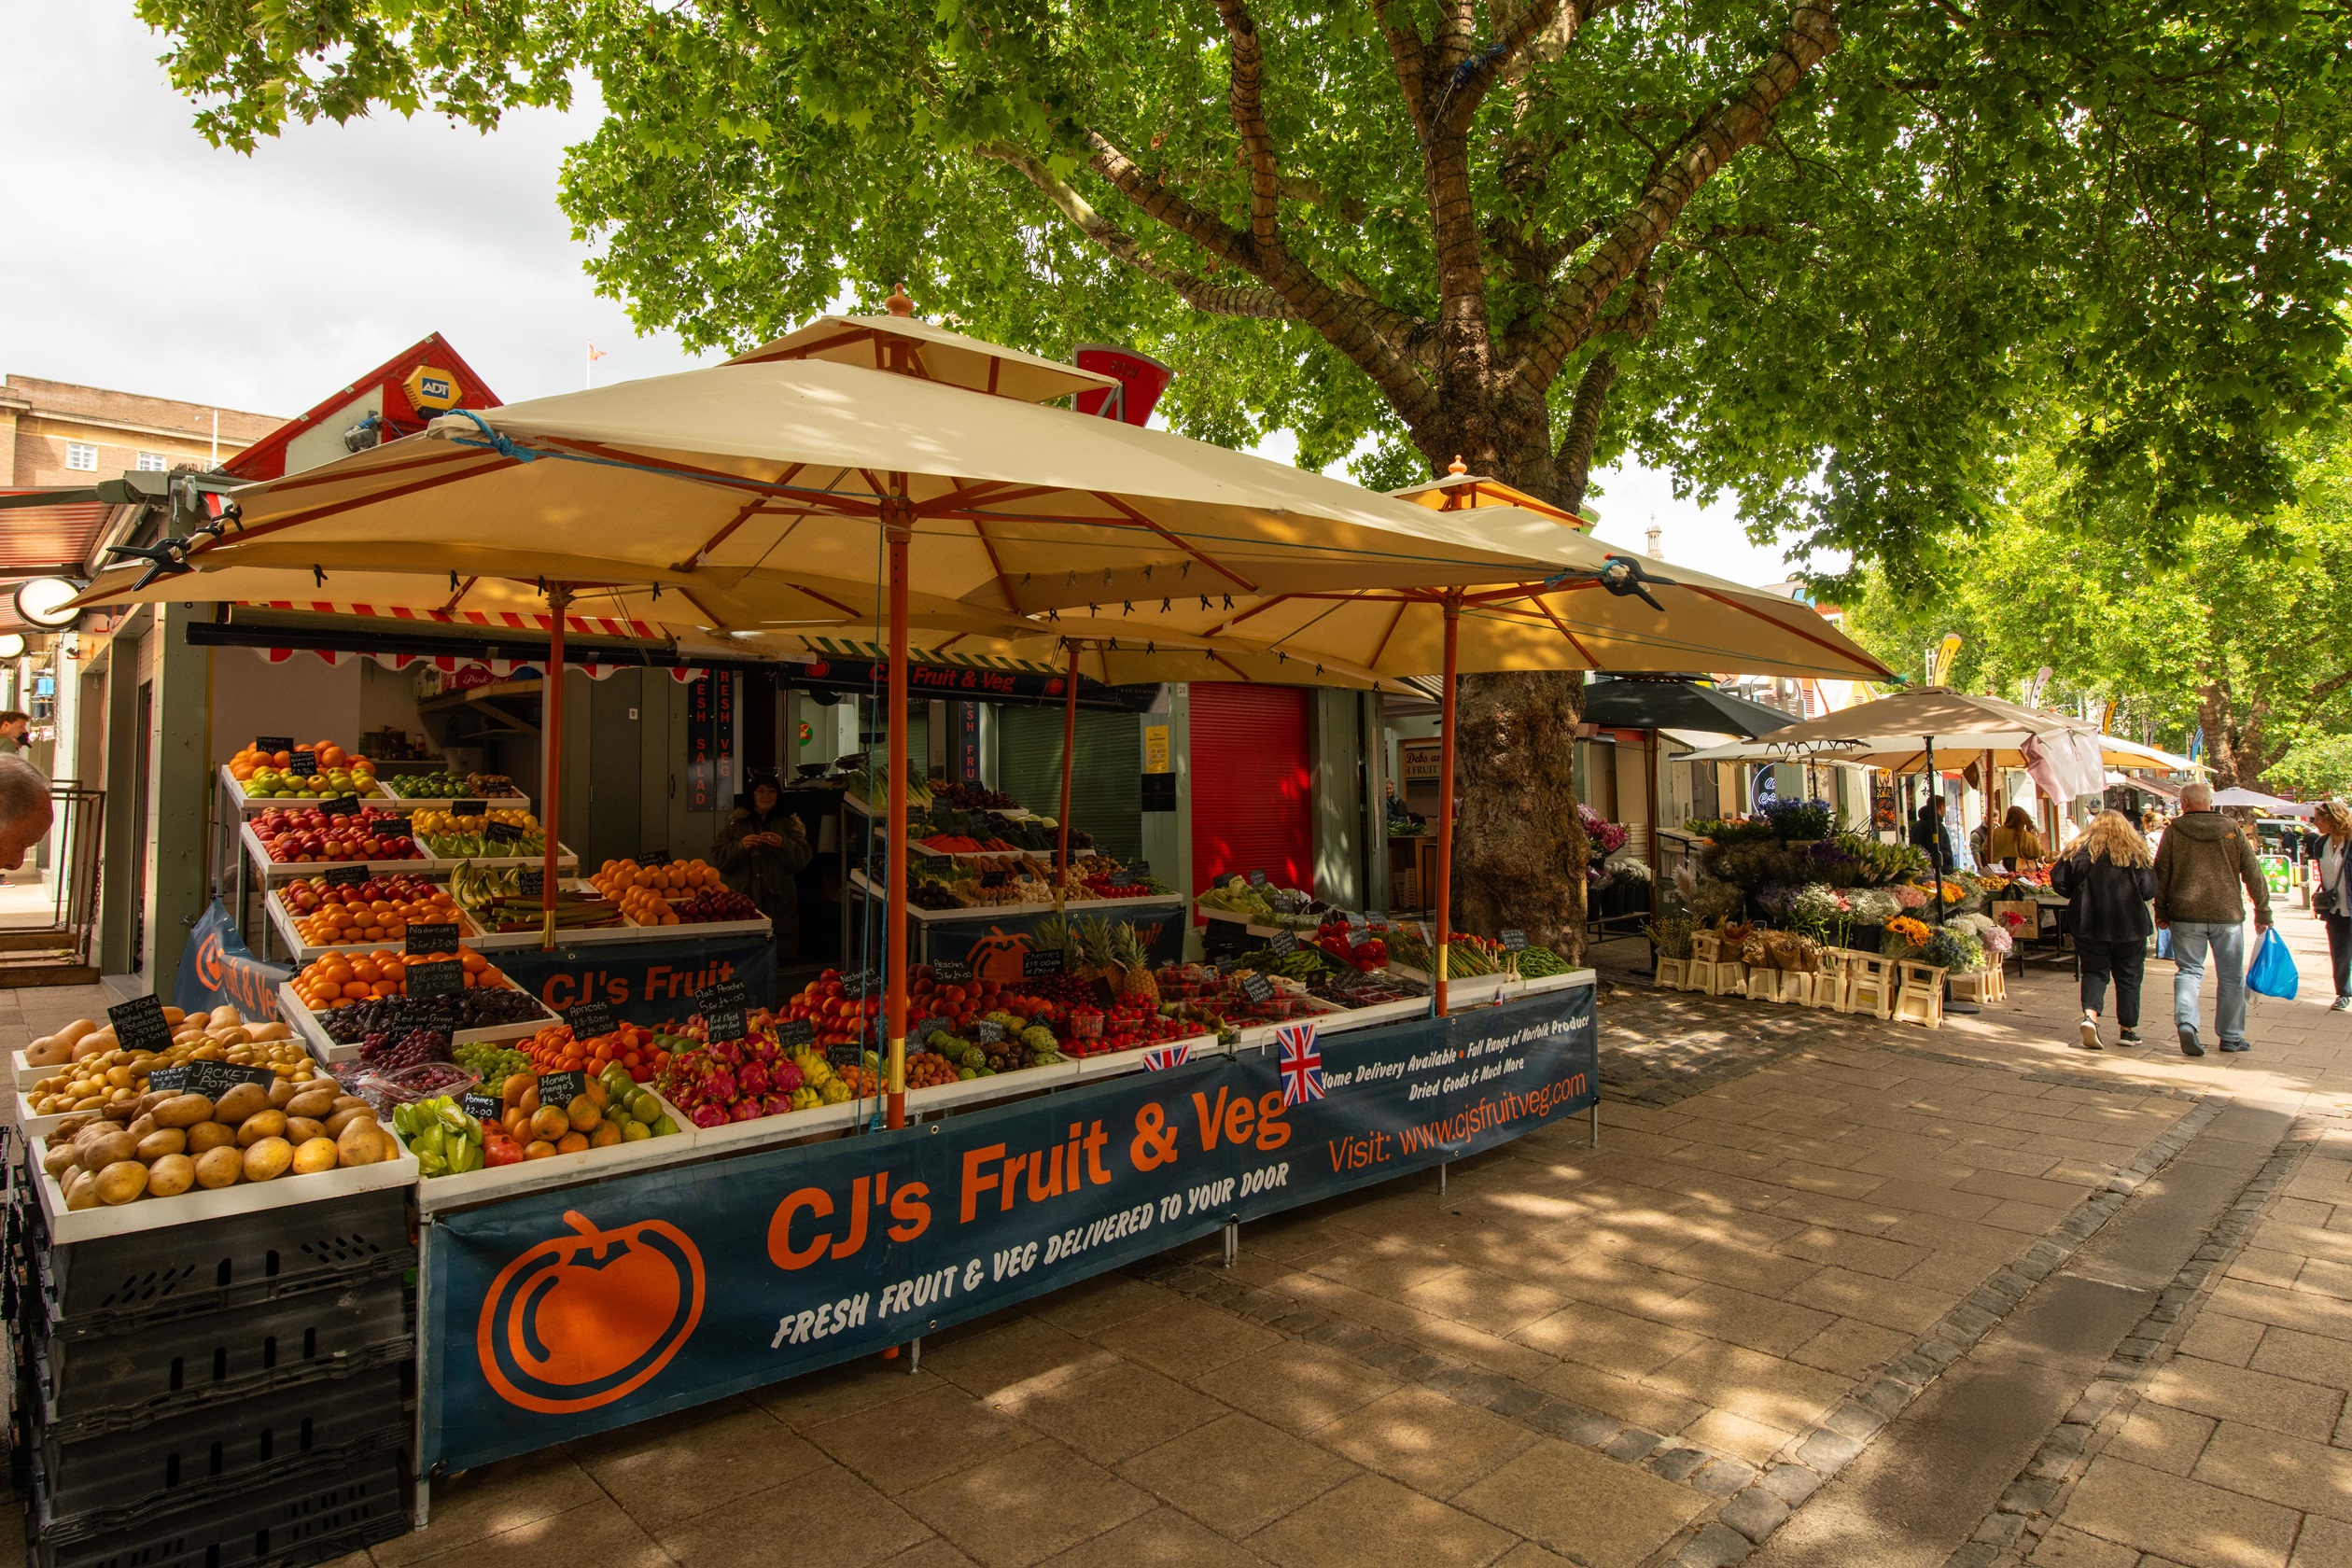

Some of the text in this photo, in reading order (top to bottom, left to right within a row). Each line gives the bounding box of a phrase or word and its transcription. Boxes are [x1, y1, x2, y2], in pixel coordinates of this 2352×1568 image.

[1110, 360, 1140, 379] ROW
[423, 382, 449, 396] ADT
[463, 674, 488, 684] Pink
[913, 666, 956, 687] Fruit
[960, 670, 976, 688] &
[982, 671, 1016, 693] Veg
[720, 671, 730, 777] RESH VEG
[694, 677, 707, 805] ESH SALAD
[966, 745, 975, 778] FRU
[1407, 752, 1428, 763] Debs
[1412, 765, 1437, 775] FRUIT
[408, 937, 418, 950] 5
[1025, 951, 1060, 961] Cherries
[933, 959, 965, 969] Peaches
[935, 968, 945, 980] 5
[542, 960, 735, 1011] CJ's Fruit
[694, 982, 745, 1001] Flat Peaches
[255, 971, 276, 1021] Ve
[569, 1001, 608, 1016] Apricots
[699, 1000, 709, 1015] 5
[709, 1002, 718, 1011] for
[121, 1014, 165, 1032] Potatoes
[394, 1012, 413, 1023] Red
[429, 1014, 454, 1023] Green
[1355, 1058, 1405, 1084] Delivery
[1407, 1046, 1458, 1072] Available
[1466, 1040, 1483, 1059] Full
[1485, 1034, 1510, 1055] Range
[1511, 1031, 1522, 1046] of
[1521, 1024, 1549, 1043] Norfolk
[1551, 1014, 1589, 1035] Produce
[151, 1066, 192, 1077] NORFO
[153, 1073, 184, 1082] NEW
[193, 1060, 255, 1083] JACKET
[1408, 1057, 1524, 1101] Dried Goods & Much More
[541, 1072, 571, 1087] Honey
[539, 1081, 575, 1095] mango's
[465, 1092, 495, 1106] Pommes
[1329, 1072, 1587, 1173] Visit: www.cjsfruitveg.com
[766, 1085, 1293, 1271] CJ's Fruit & Veg
[771, 1162, 1289, 1350] FRESH FRUIT & VEG DELIVERED TO YOUR DOOR
